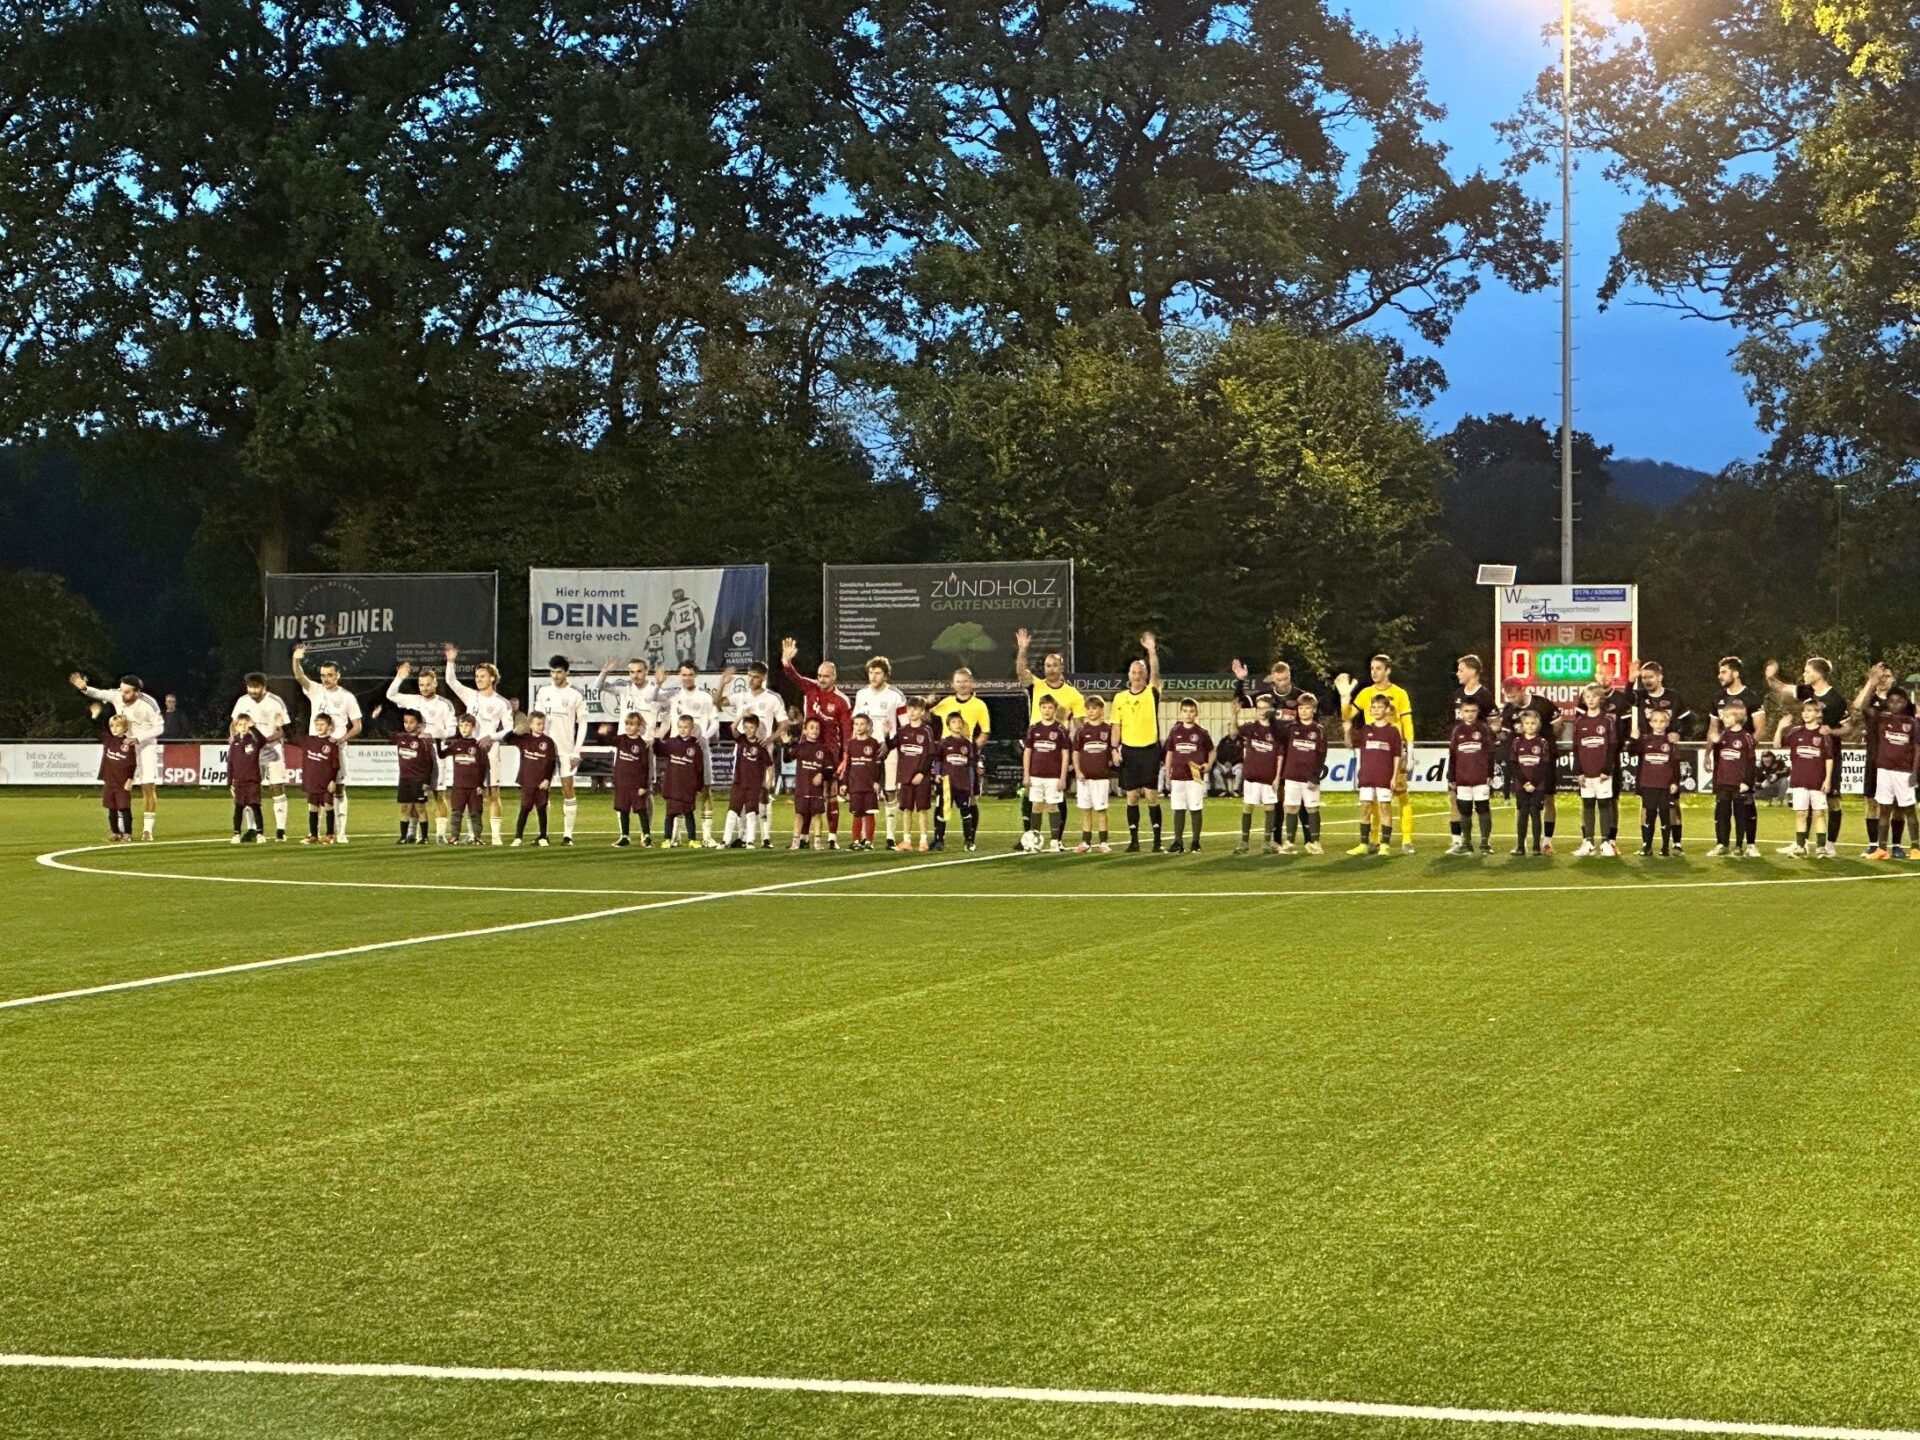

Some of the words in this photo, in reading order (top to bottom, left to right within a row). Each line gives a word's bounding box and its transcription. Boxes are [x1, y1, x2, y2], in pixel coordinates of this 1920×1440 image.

[556, 587, 580, 598] Hier
[584, 587, 625, 598] kommt
[541, 602, 639, 627] DEINE
[679, 610, 690, 623] 12
[273, 613, 326, 640] MOE'S
[338, 608, 394, 636] DINER
[548, 630, 593, 643] Energie
[596, 631, 631, 642] wech.
[1507, 628, 1551, 642] HEIM
[1580, 627, 1626, 641] GAST
[1512, 649, 1530, 679] 0
[1541, 653, 1592, 674] 00:00
[164, 767, 197, 783] SPD
